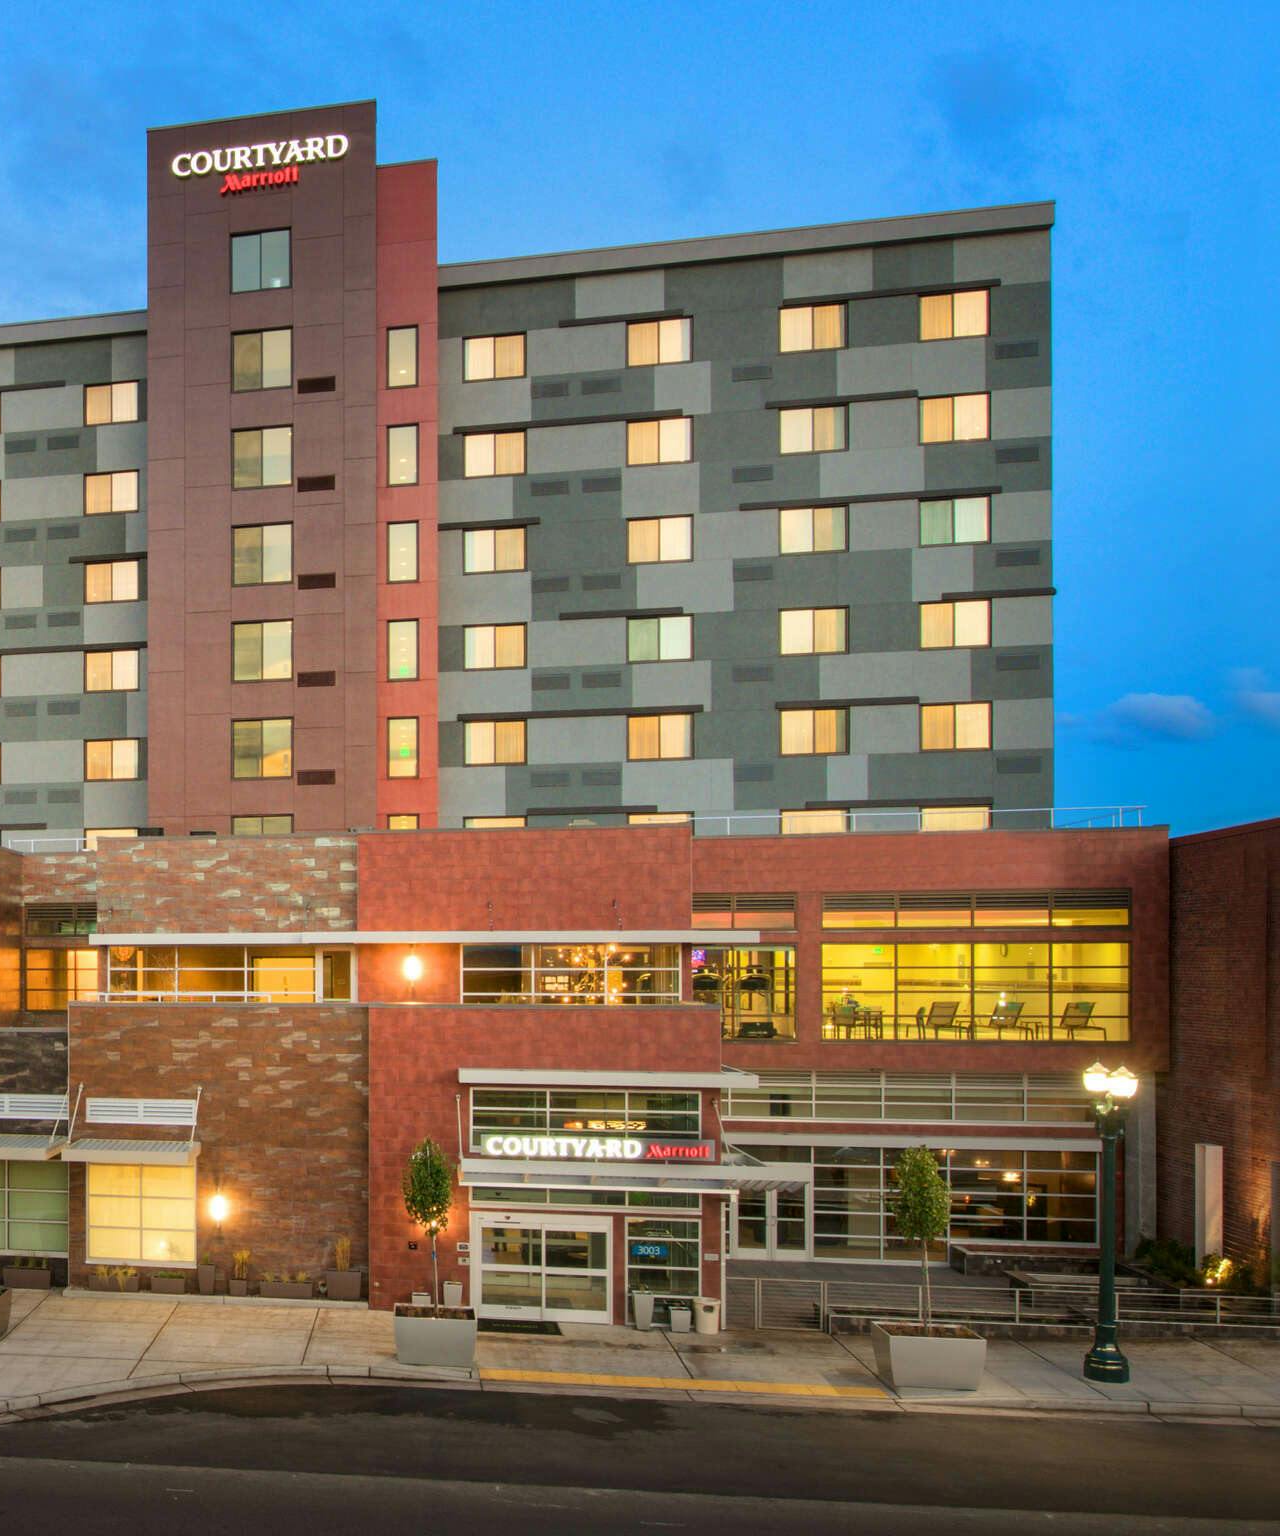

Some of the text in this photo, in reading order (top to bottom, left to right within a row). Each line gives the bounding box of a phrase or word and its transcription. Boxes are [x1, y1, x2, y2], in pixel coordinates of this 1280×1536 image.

[171, 133, 350, 178] COURTYARD
[220, 164, 299, 194] Marriott
[486, 1136, 710, 1159] COURTYARD Marriott
[637, 1245, 661, 1255] 3003
